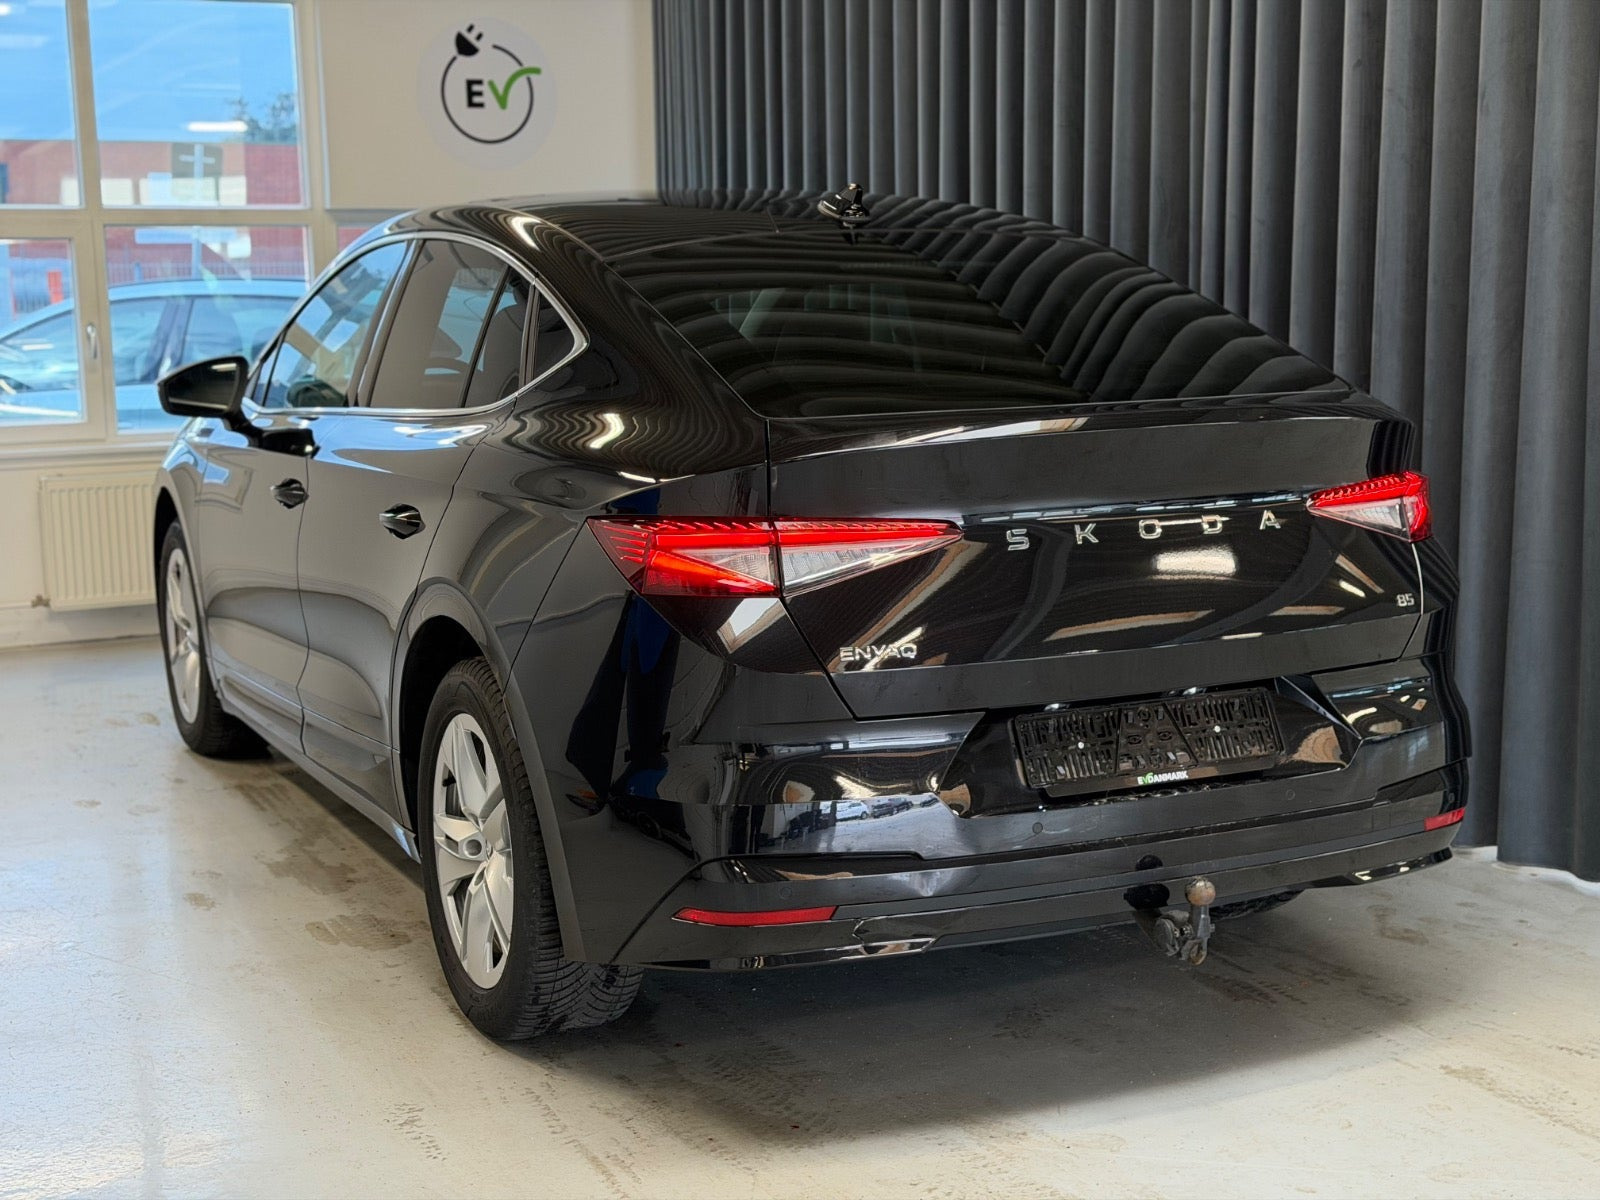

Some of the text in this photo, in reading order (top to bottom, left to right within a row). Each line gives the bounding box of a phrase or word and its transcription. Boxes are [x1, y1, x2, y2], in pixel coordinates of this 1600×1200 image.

[465, 66, 542, 110] EV
[1396, 592, 1415, 607] 85
[839, 642, 918, 662] ENYAQ
